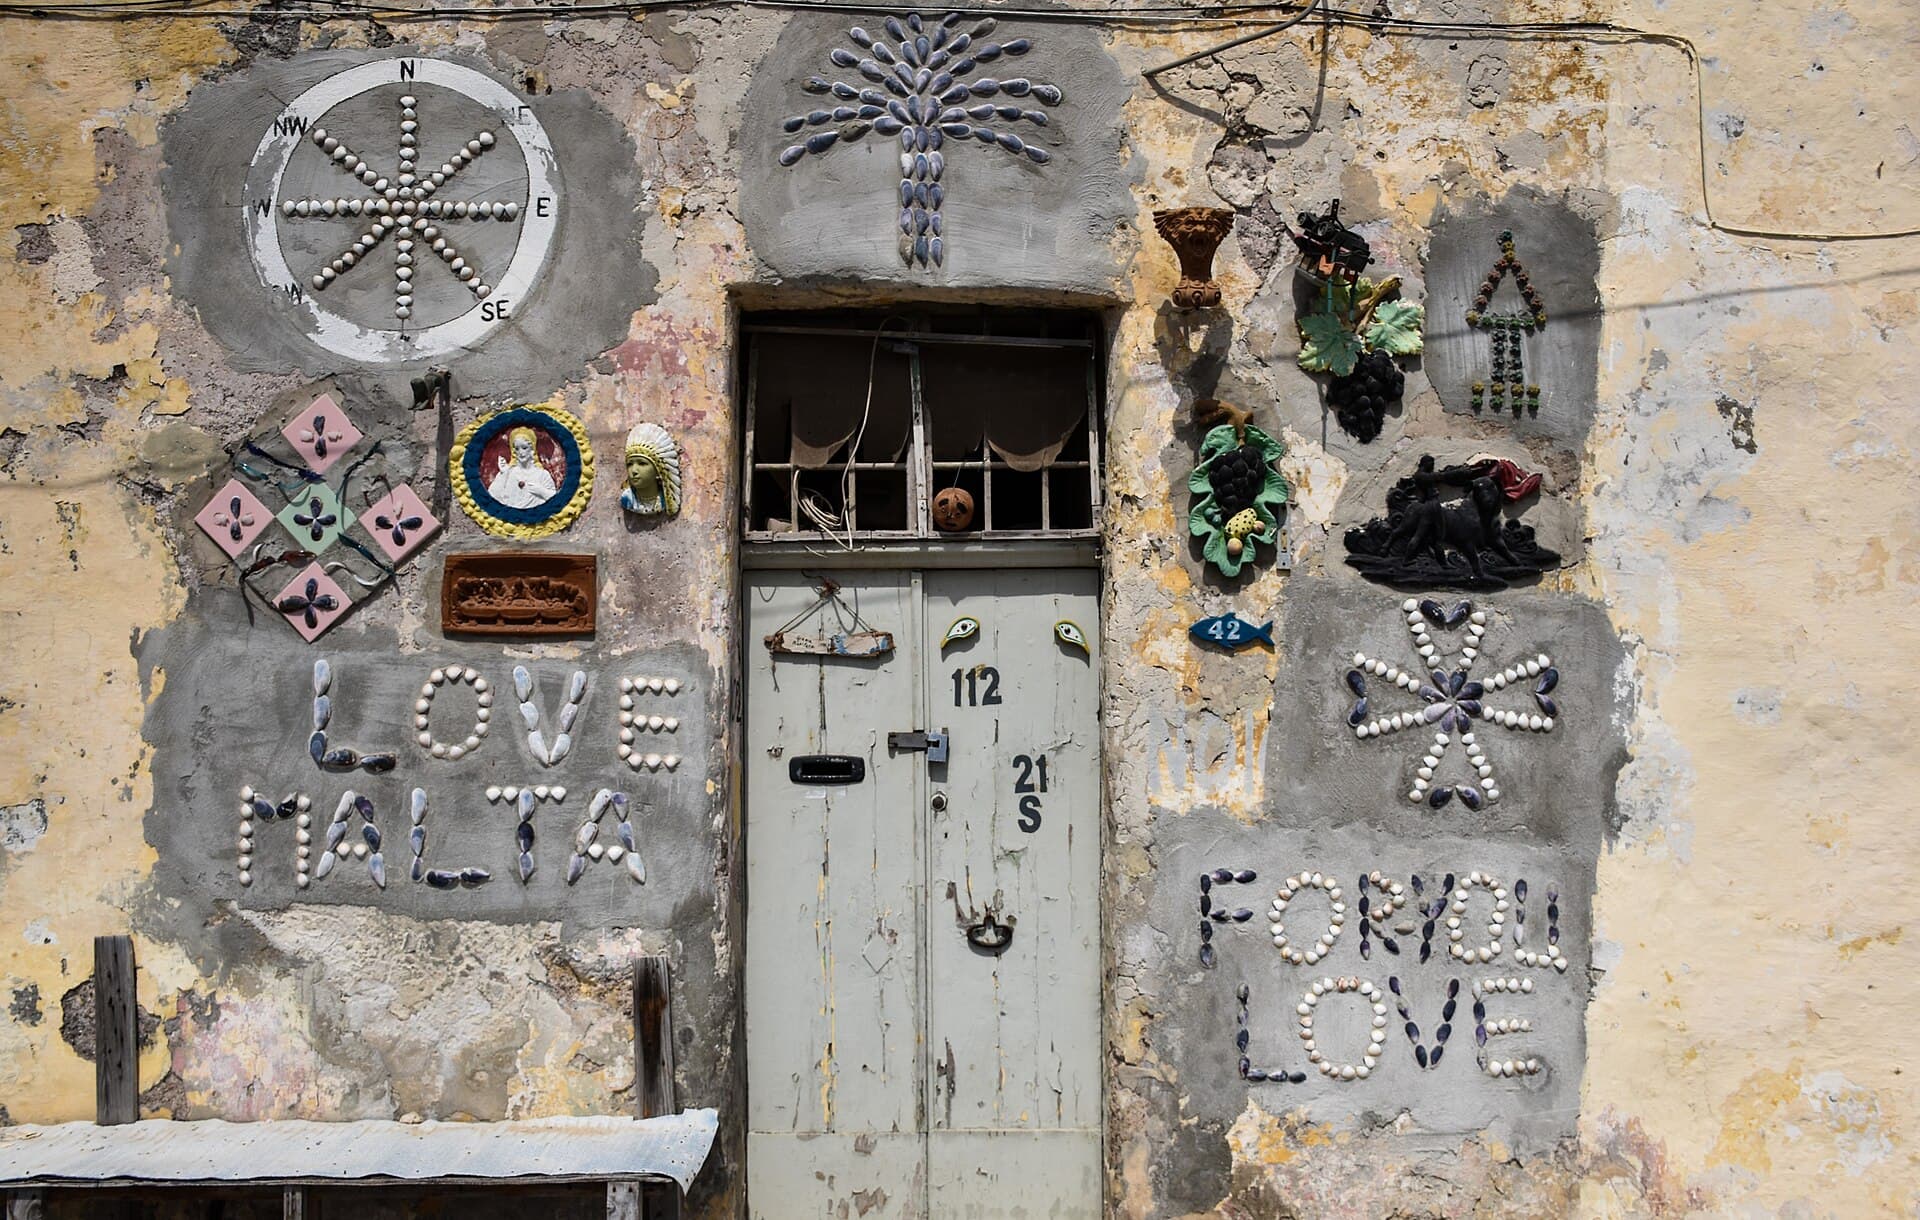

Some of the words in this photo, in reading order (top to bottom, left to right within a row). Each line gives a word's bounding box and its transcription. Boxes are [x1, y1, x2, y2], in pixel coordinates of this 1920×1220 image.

[401, 59, 415, 82] N
[273, 116, 308, 137] NW
[252, 195, 272, 218] W
[536, 197, 551, 217] E
[480, 299, 511, 322] SE
[1207, 620, 1241, 640] 42
[951, 666, 1003, 707] 112
[308, 658, 684, 774] LOVE
[1012, 754, 1049, 794] 21
[1017, 794, 1043, 834] S
[238, 786, 647, 888] MALTA
[1236, 975, 1543, 1084] LOVE
